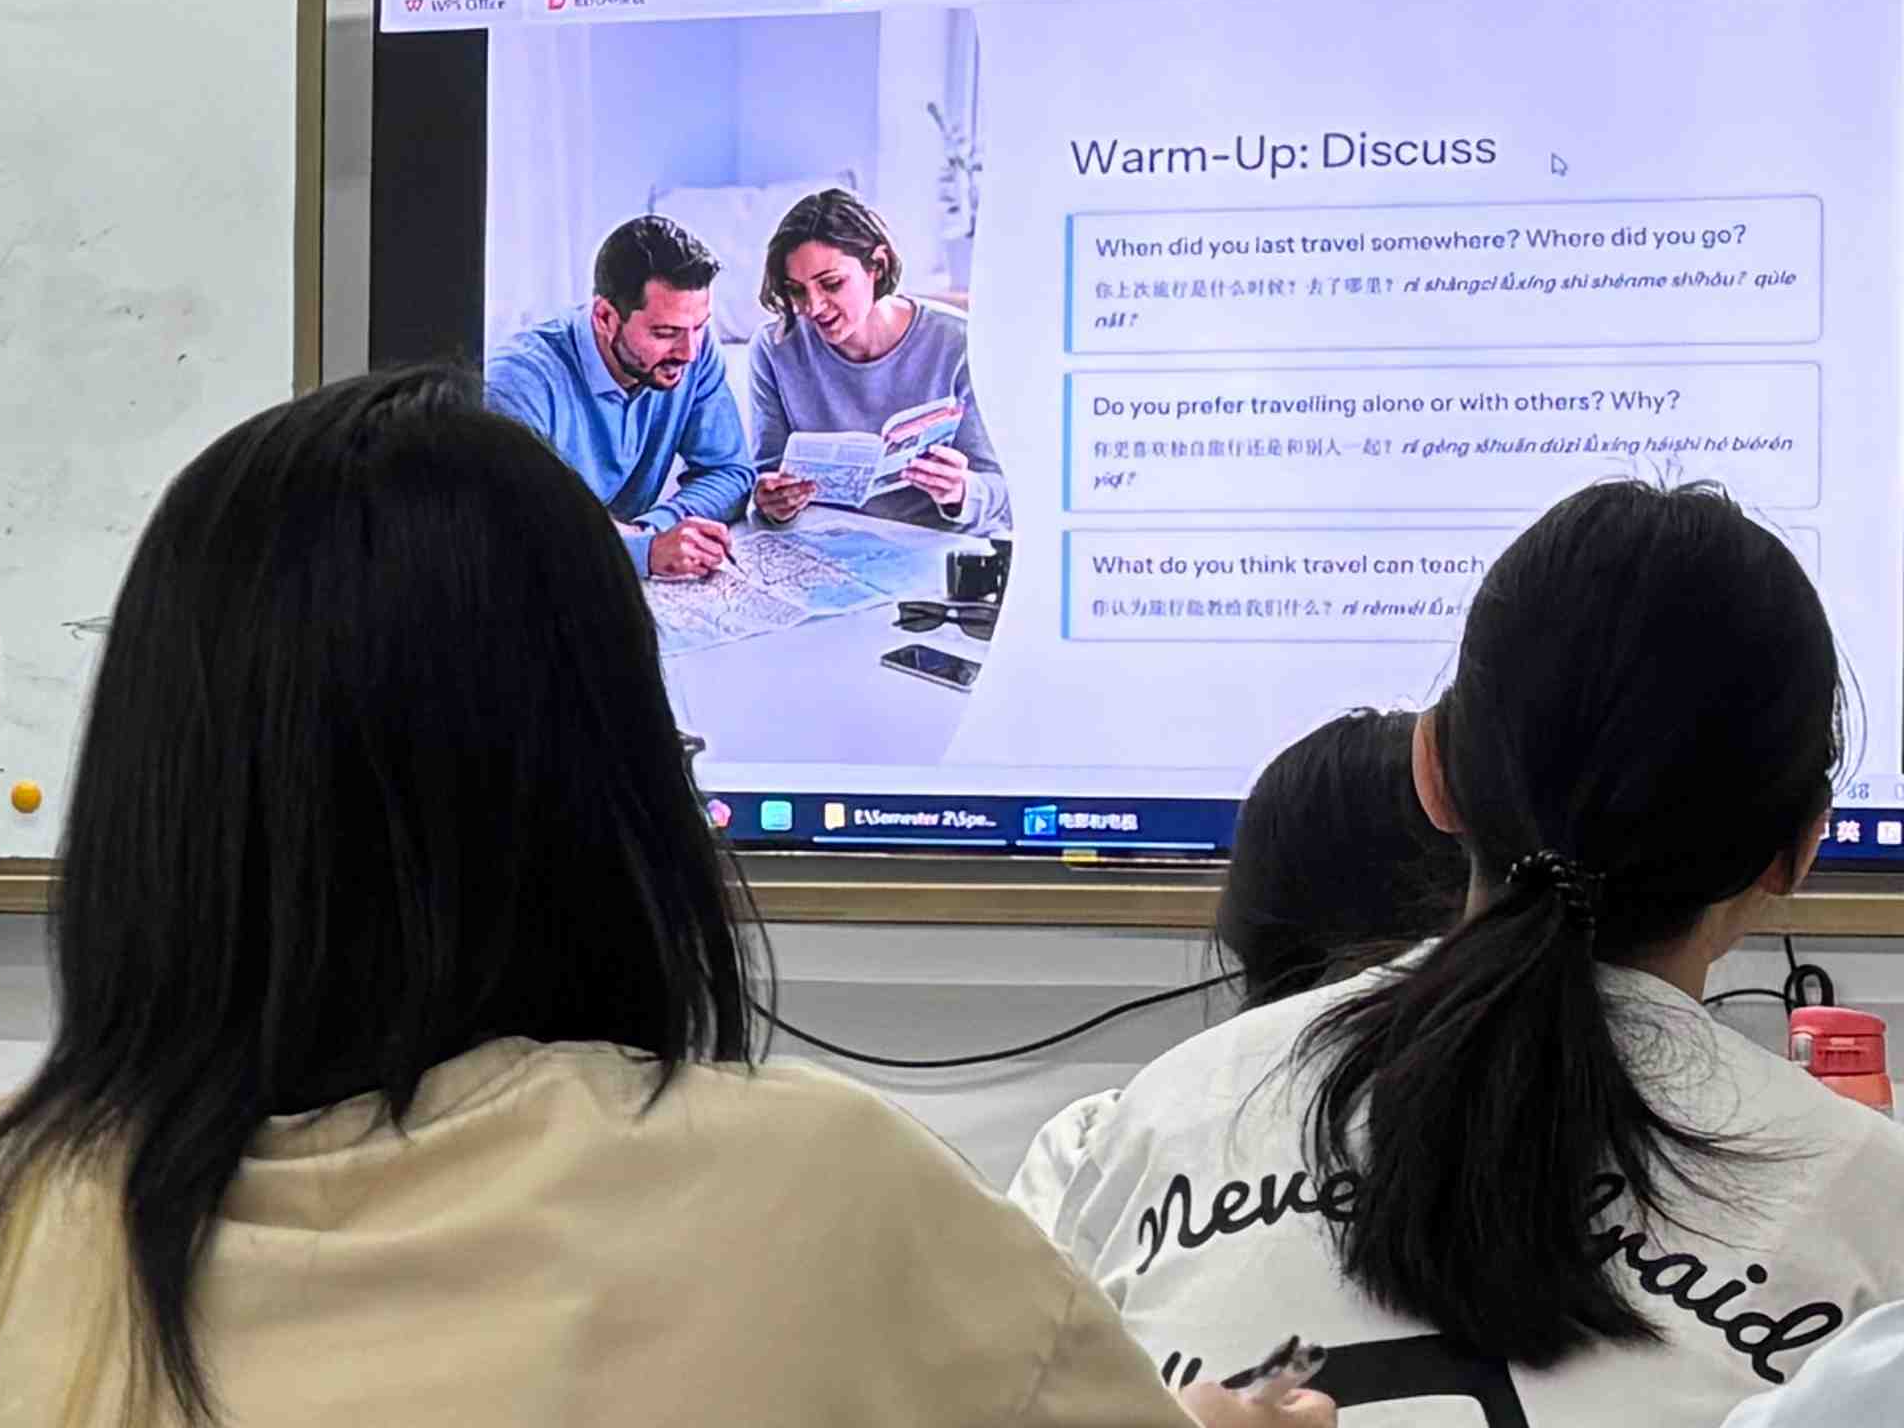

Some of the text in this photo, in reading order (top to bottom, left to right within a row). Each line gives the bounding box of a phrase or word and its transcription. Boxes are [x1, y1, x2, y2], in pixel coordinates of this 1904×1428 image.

[1071, 132, 1497, 180] Warm-Up: Discuss
[1096, 225, 1747, 259] When did you last travel somewhere? Where did you go?
[1093, 390, 1681, 419] Do you prefer travelling alone or with others? Why?
[1092, 555, 1486, 578] What do you think travel can teach
[1135, 1173, 1367, 1276] Neve
